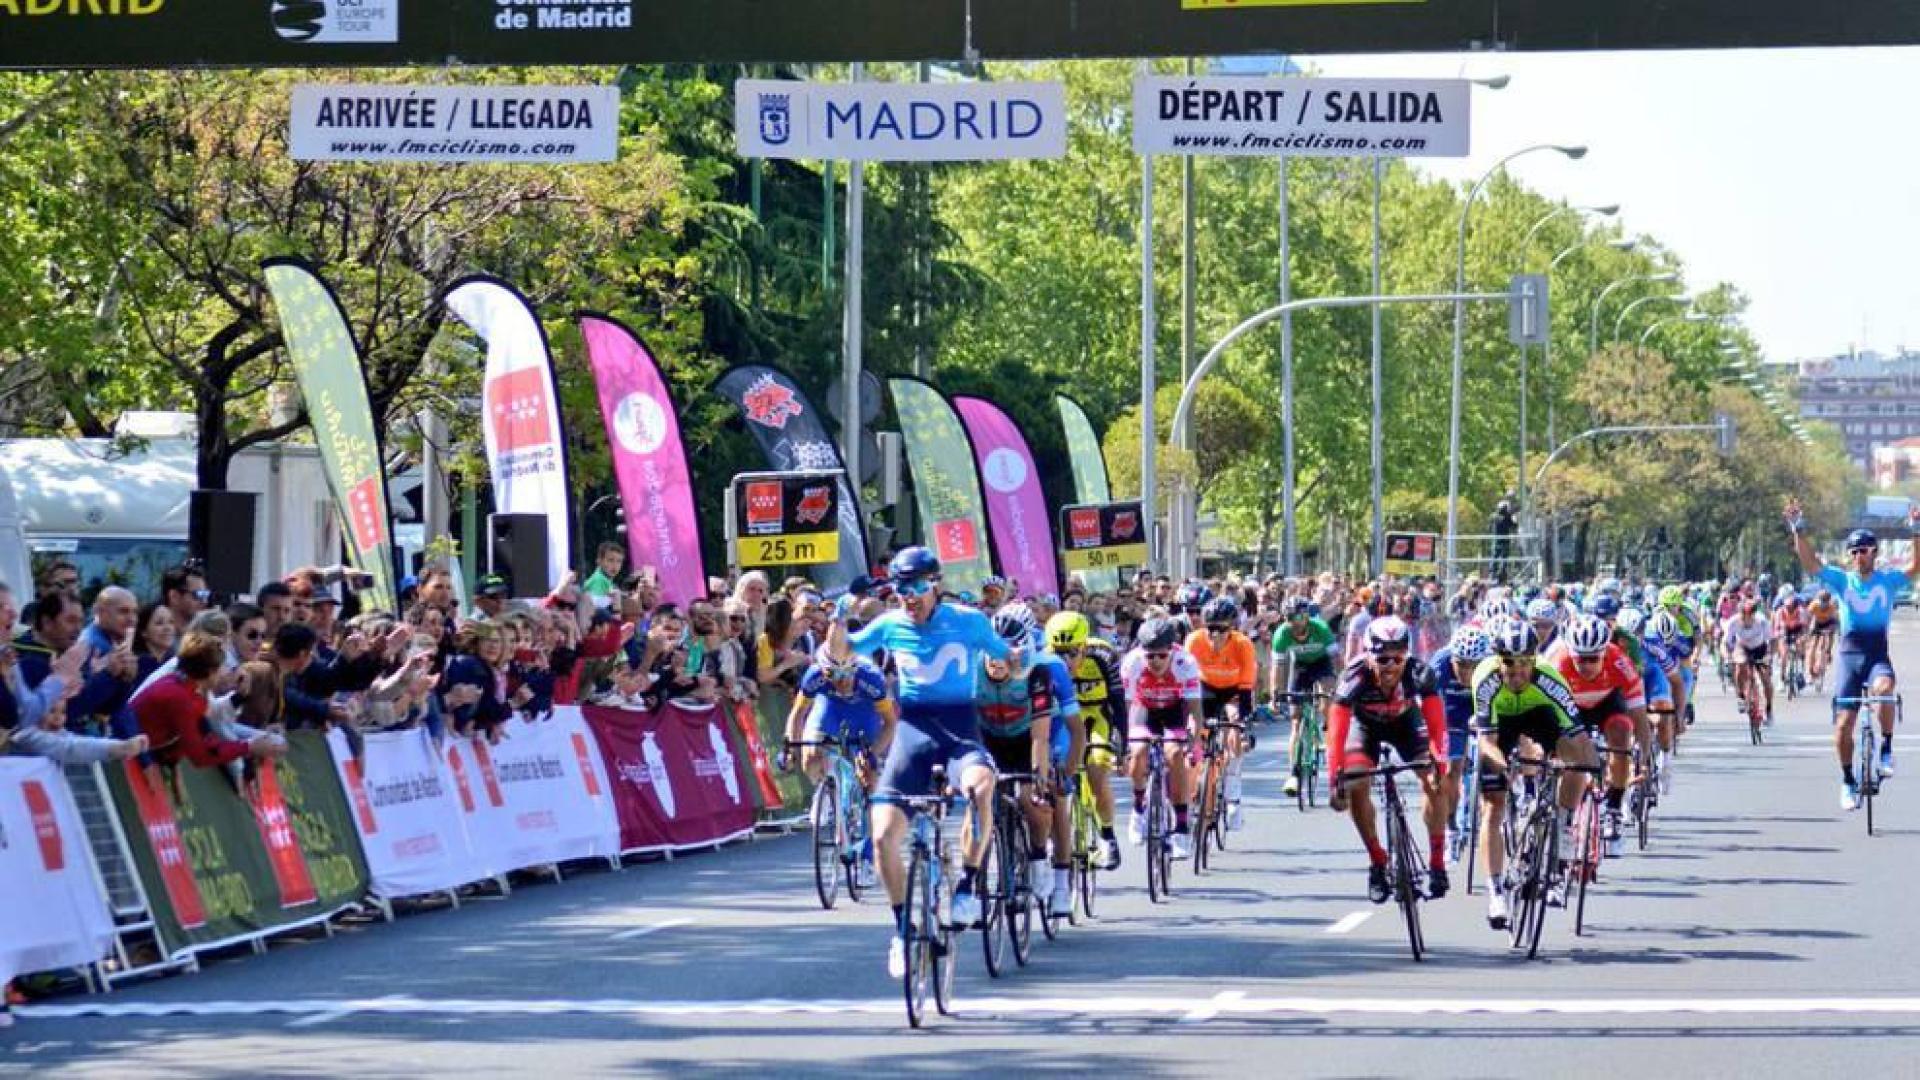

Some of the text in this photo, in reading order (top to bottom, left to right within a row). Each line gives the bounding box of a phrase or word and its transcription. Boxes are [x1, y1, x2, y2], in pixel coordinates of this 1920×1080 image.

[336, 8, 385, 19] EUROPE
[494, 6, 632, 29] de Madrid
[338, 21, 371, 31] TOUR
[315, 89, 437, 129] ARRIVÉE
[470, 98, 593, 130] LLEGADA
[1158, 81, 1284, 121] DÉPART
[1323, 90, 1443, 123] SALIDA
[825, 99, 1043, 140] MADRID
[329, 138, 576, 155] www.fmciclismo.com
[1172, 132, 1427, 150] www.fmciclismo.com
[759, 540, 816, 561] 25 m
[1087, 550, 1120, 567] 50 m
